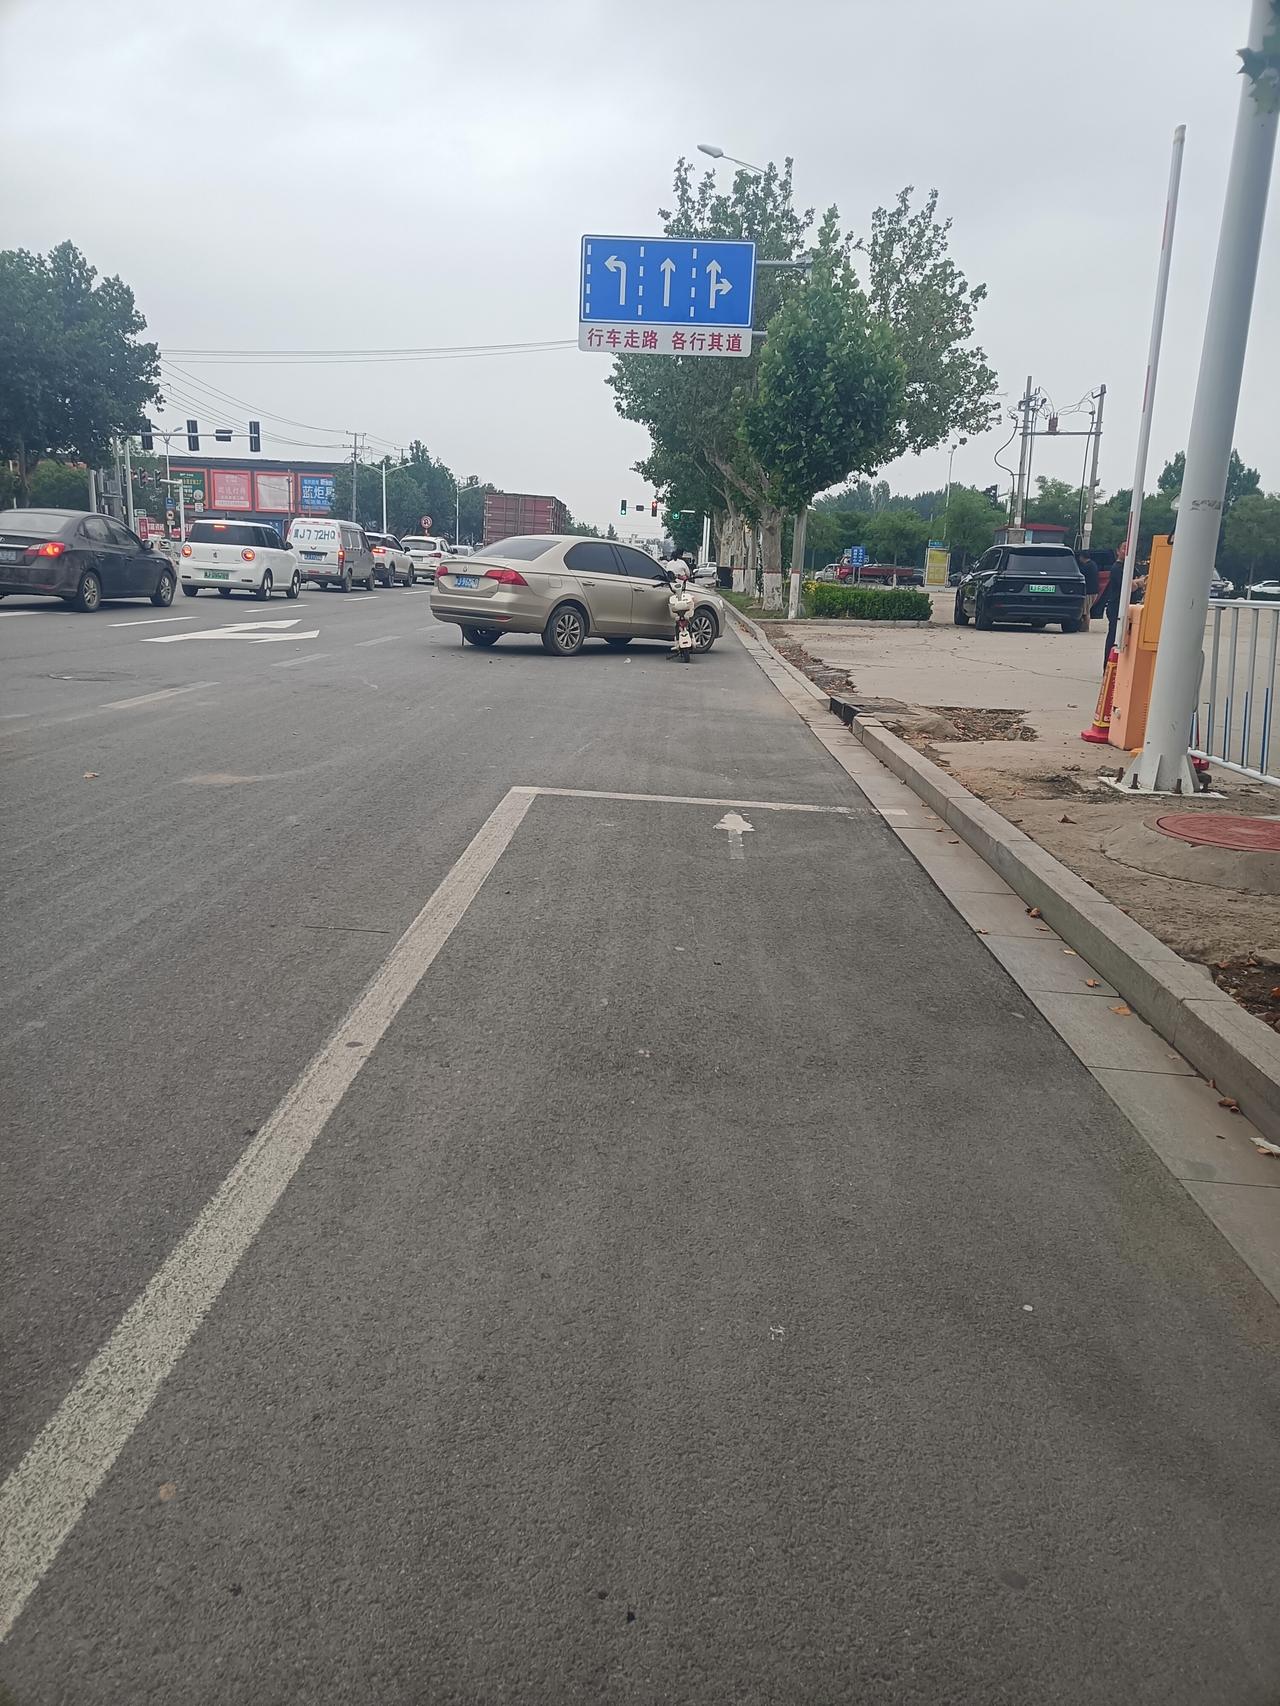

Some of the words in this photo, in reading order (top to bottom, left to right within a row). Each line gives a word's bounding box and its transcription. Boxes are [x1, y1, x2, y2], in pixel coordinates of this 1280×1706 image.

[587, 328, 658, 350] 行车走路
[672, 331, 743, 352] 各行其道
